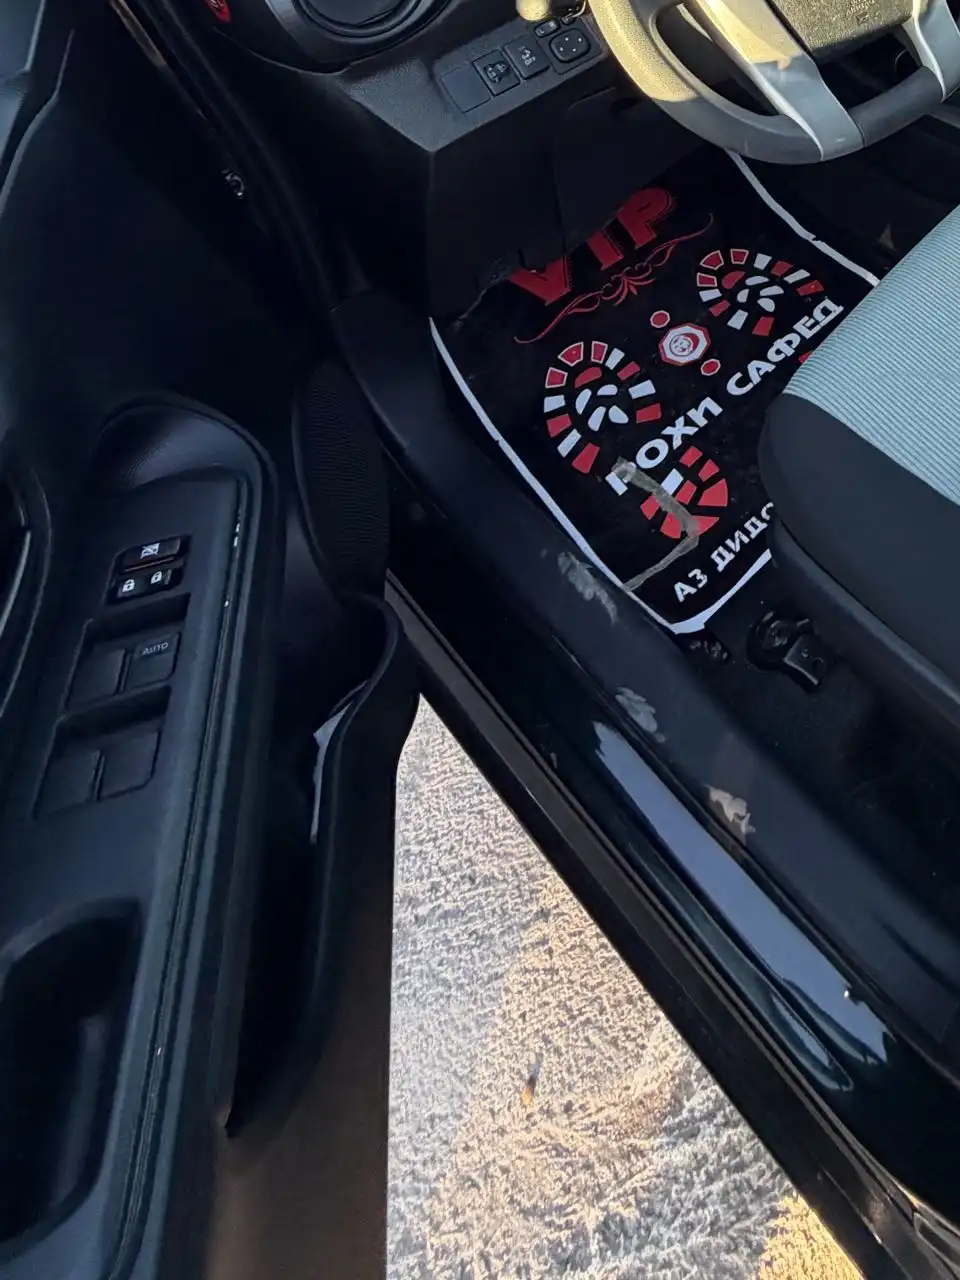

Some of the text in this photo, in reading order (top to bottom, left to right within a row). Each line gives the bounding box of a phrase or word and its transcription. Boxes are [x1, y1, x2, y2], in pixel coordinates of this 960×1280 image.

[507, 187, 676, 307] VIP
[726, 297, 845, 396] САФЕД
[673, 568, 709, 604] АЗ
[142, 641, 169, 656] AUTO
